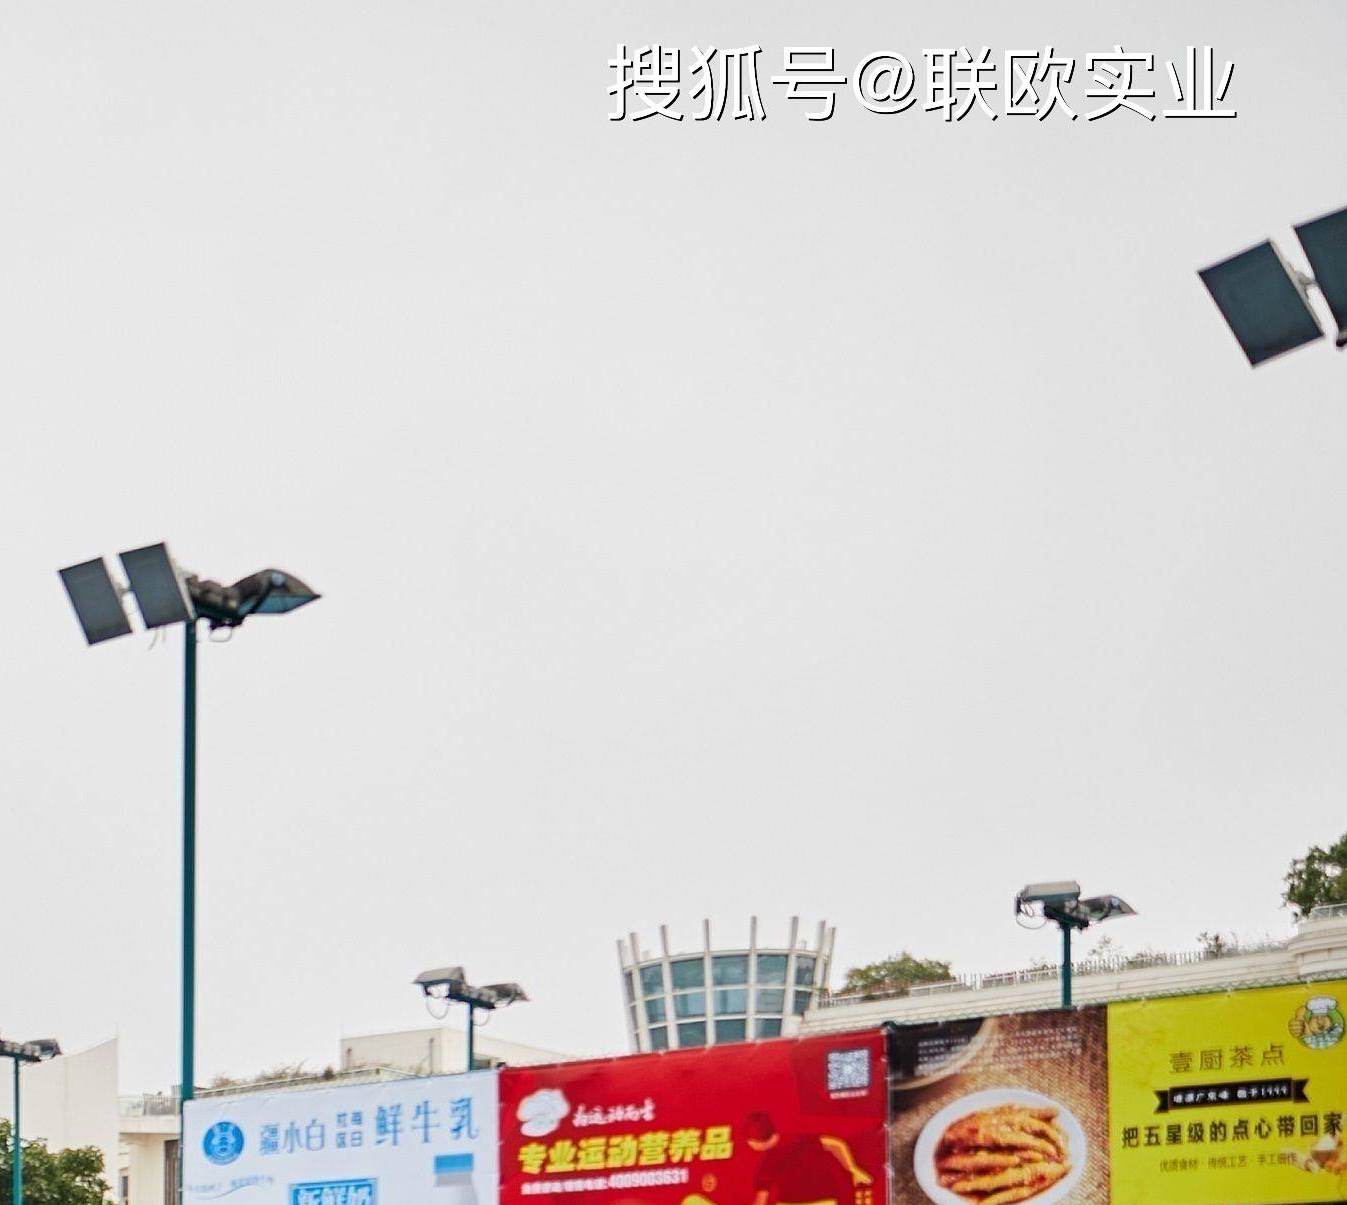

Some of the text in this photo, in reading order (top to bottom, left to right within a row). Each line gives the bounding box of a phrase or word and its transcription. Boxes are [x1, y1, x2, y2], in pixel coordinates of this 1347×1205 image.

[1169, 1044, 1286, 1074] 壹厨茶点
[374, 1097, 480, 1146] 鲜牛乳
[1122, 1112, 1343, 1149] 把五星级的点心带回家
[518, 1125, 733, 1174] 专业运动营养品
